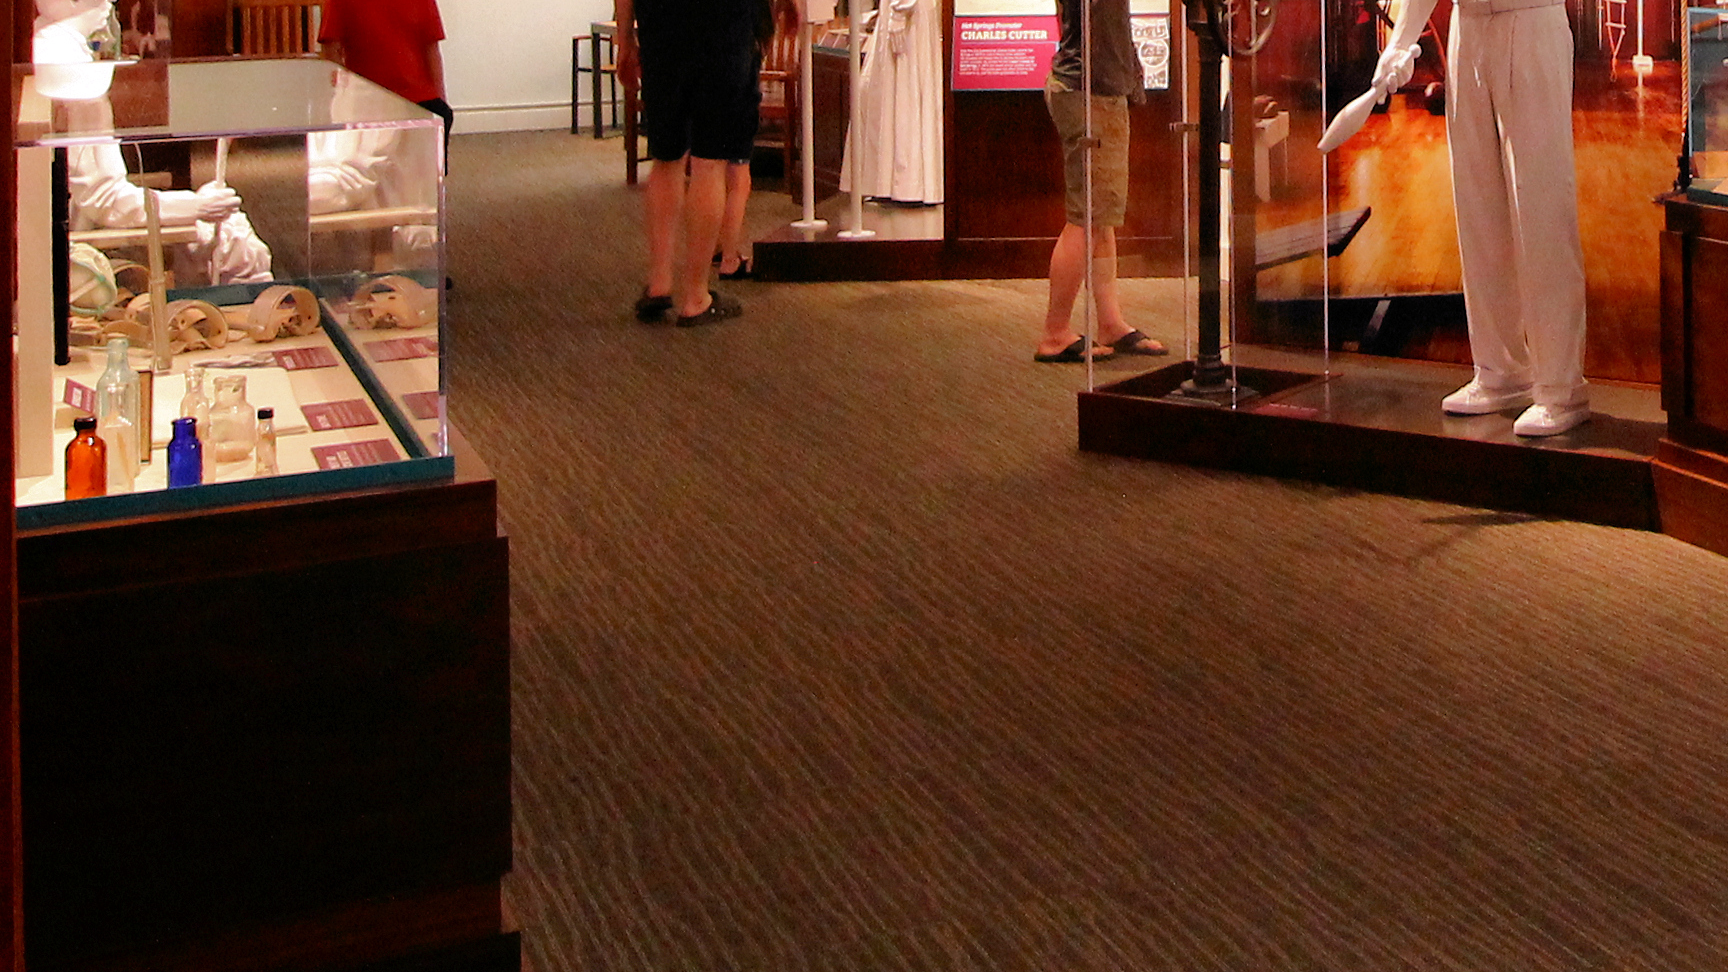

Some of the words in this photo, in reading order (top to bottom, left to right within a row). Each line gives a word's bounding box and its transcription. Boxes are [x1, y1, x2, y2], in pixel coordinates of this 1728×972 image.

[973, 23, 995, 31] Springs
[961, 31, 1007, 40] CHARLES
[1008, 30, 1048, 39] CUTTER
